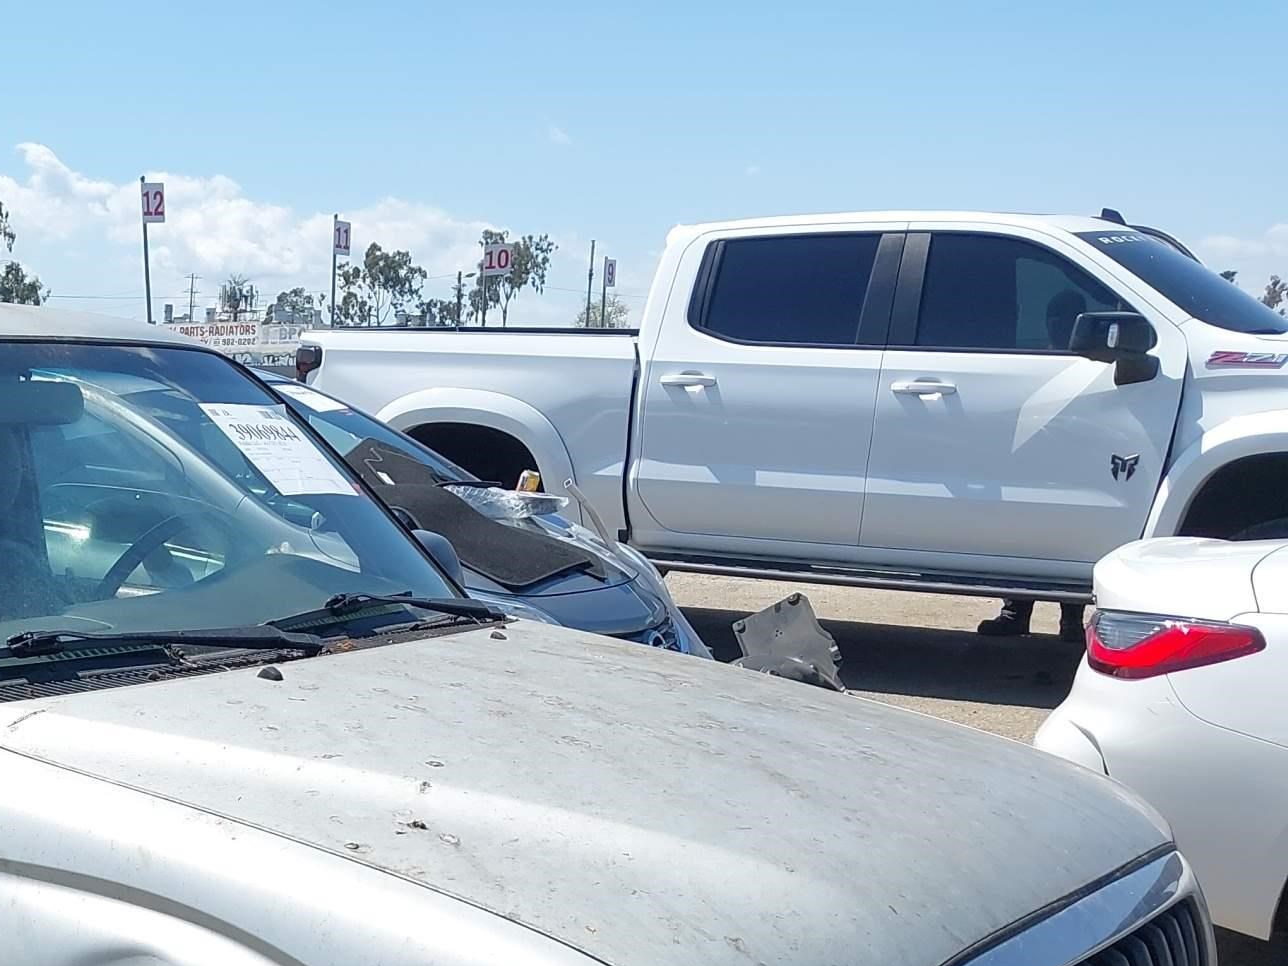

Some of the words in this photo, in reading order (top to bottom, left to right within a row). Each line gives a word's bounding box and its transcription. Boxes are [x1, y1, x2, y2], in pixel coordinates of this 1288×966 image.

[143, 190, 164, 216] 12
[335, 226, 350, 249] 11
[485, 249, 510, 270] 10
[607, 263, 614, 284] 9
[229, 423, 302, 442] 39069844
